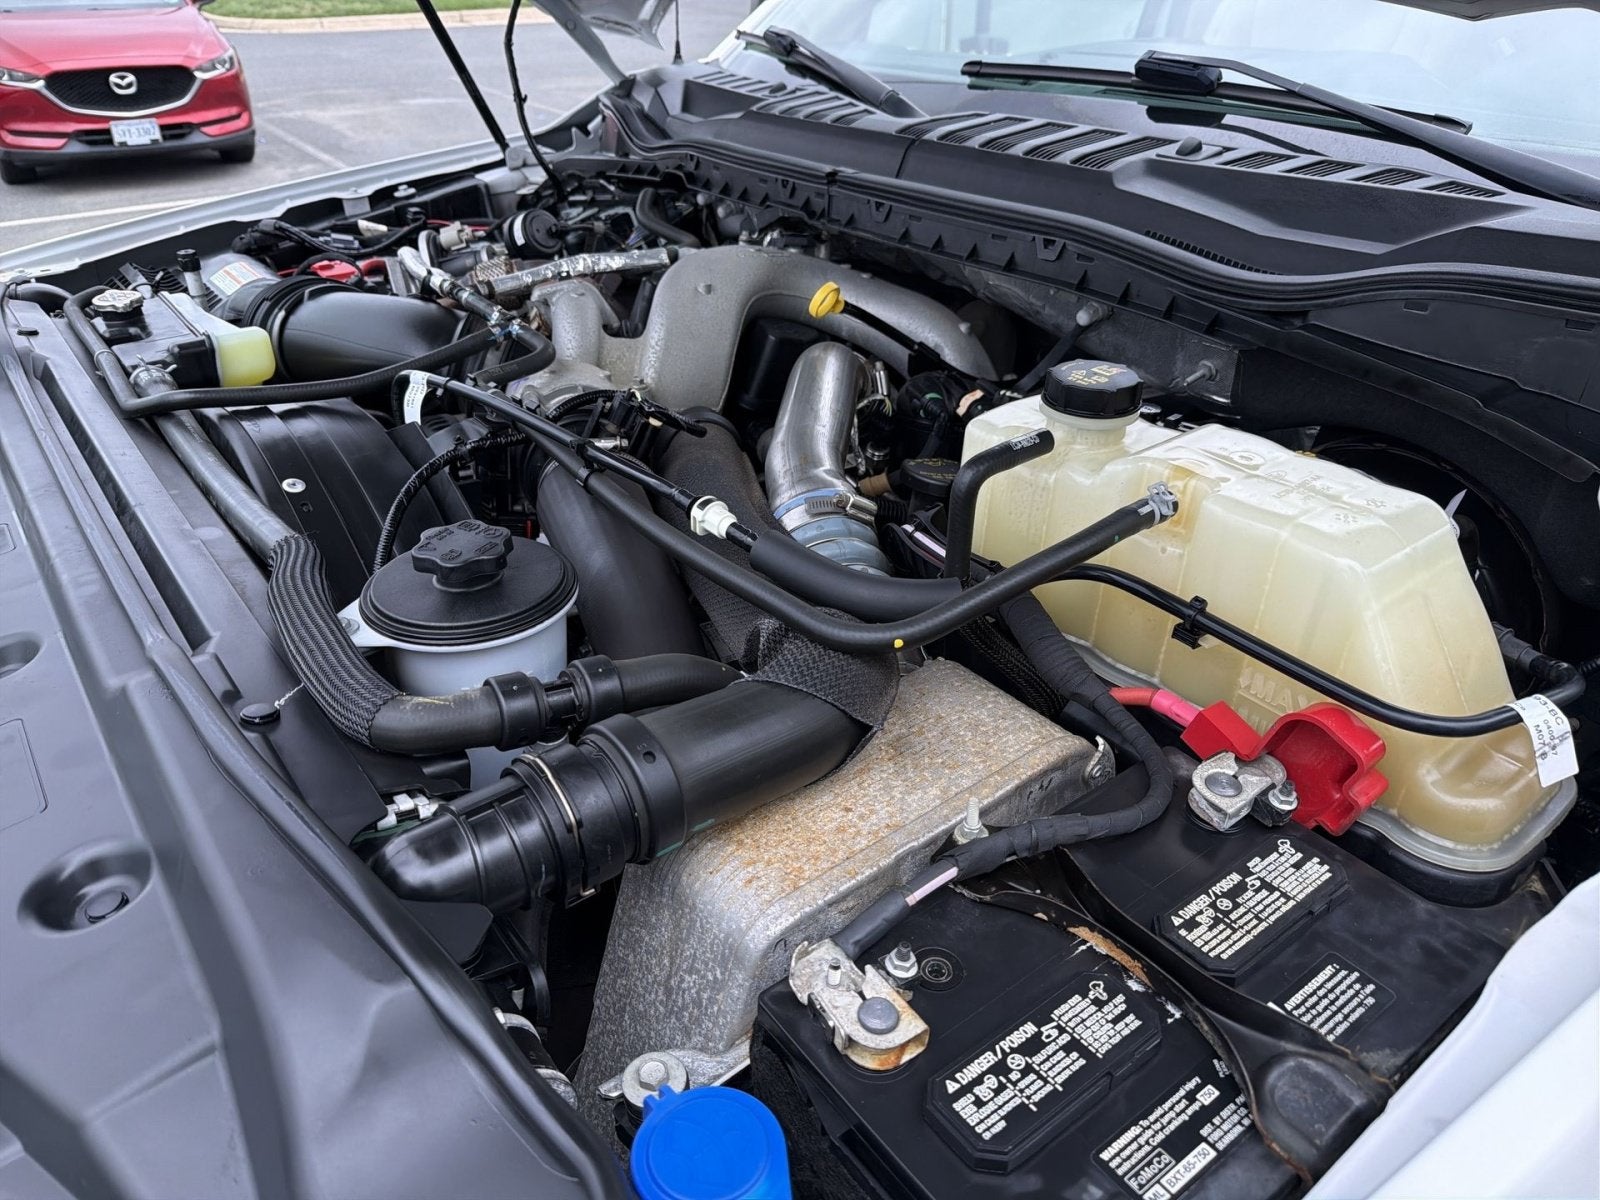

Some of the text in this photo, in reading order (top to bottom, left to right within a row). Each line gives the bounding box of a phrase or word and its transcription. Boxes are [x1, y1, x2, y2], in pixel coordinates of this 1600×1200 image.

[1284, 965, 1335, 1011] AVERTISSEMENT
[1200, 1088, 1215, 1100] 750
[1100, 1125, 1143, 1160] WARNING:
[1148, 1106, 1164, 1122] avoid
[1162, 1088, 1186, 1111] personal
[1182, 1076, 1201, 1091] injury
[1109, 1099, 1189, 1168] see owner guide for jump start
[1115, 1101, 1202, 1175] instructions. Cold cranking amps
[1208, 1128, 1224, 1144] FORD
[1220, 1113, 1240, 1131] MOTOR
[1130, 1154, 1169, 1189] FoMoCo
[1166, 1148, 1210, 1188] BXT-65-750
